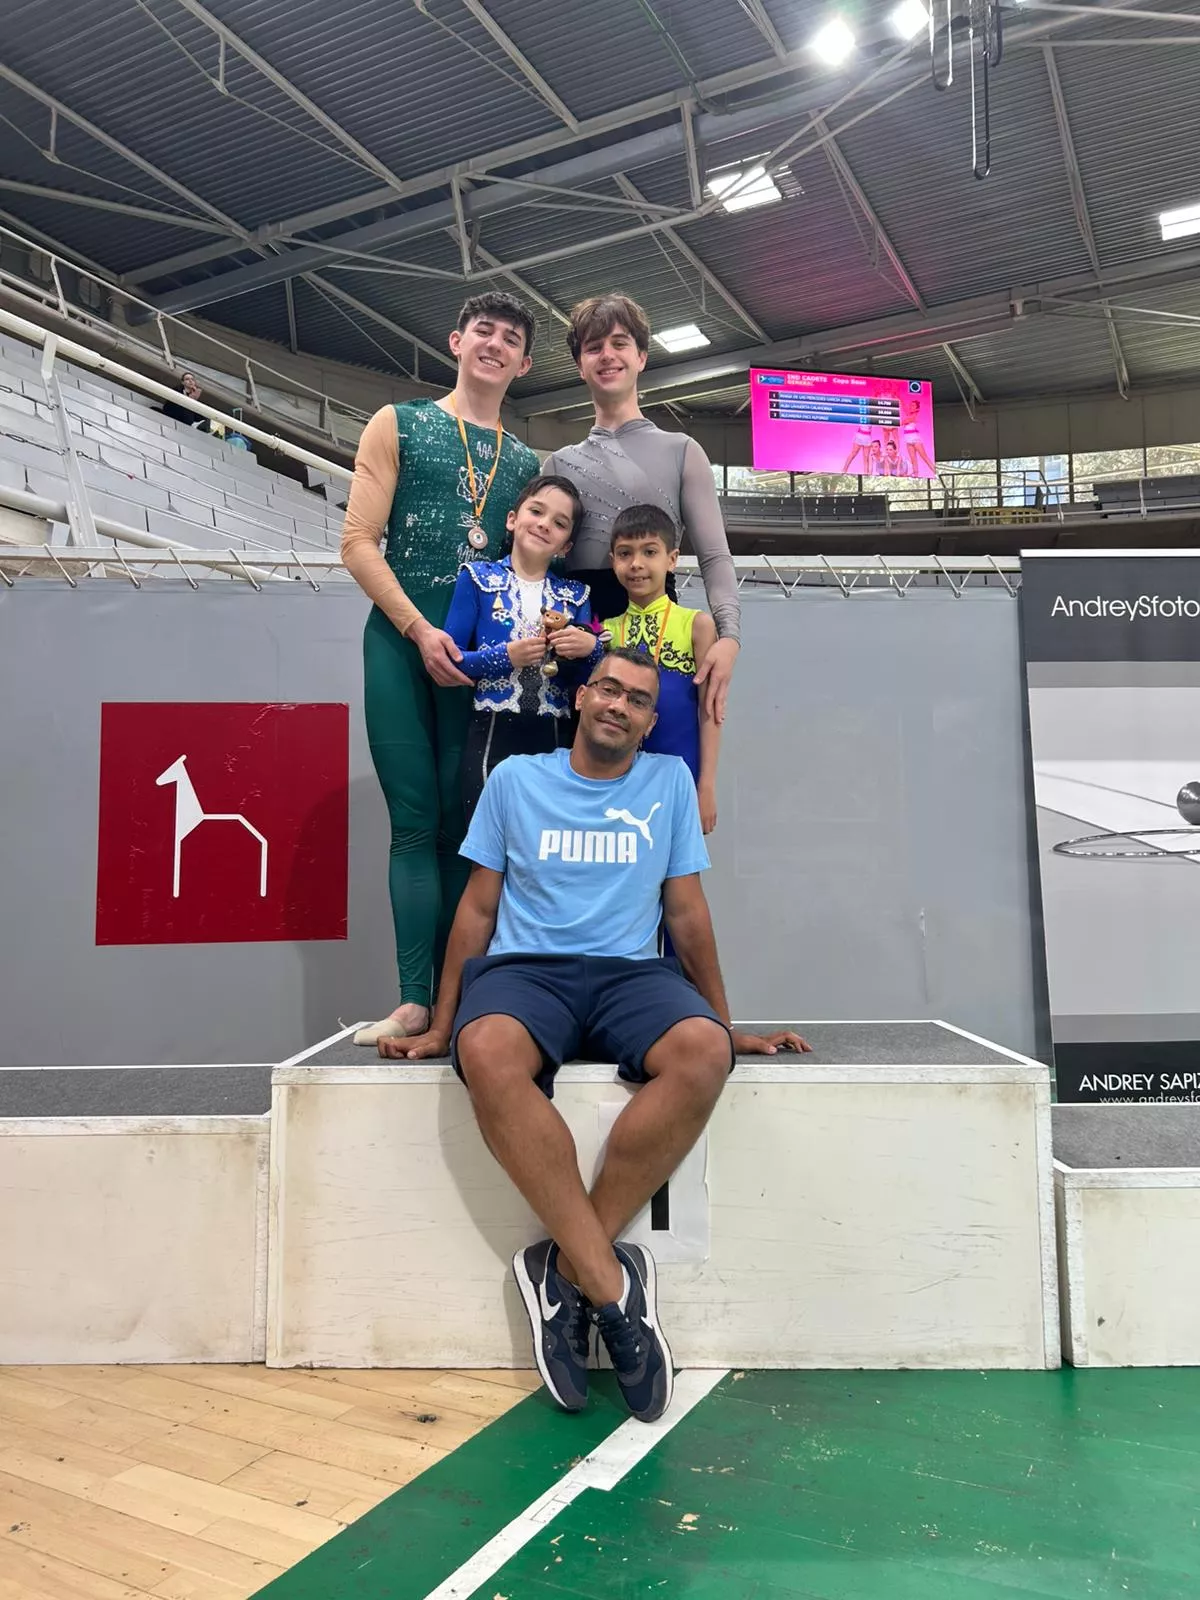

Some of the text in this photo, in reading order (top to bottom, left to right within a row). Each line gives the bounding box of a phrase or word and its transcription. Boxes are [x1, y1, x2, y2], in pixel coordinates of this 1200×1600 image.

[1051, 595, 1200, 621] AndreySfoto
[538, 829, 637, 863] PUMA
[1079, 1073, 1154, 1091] ANDREY
